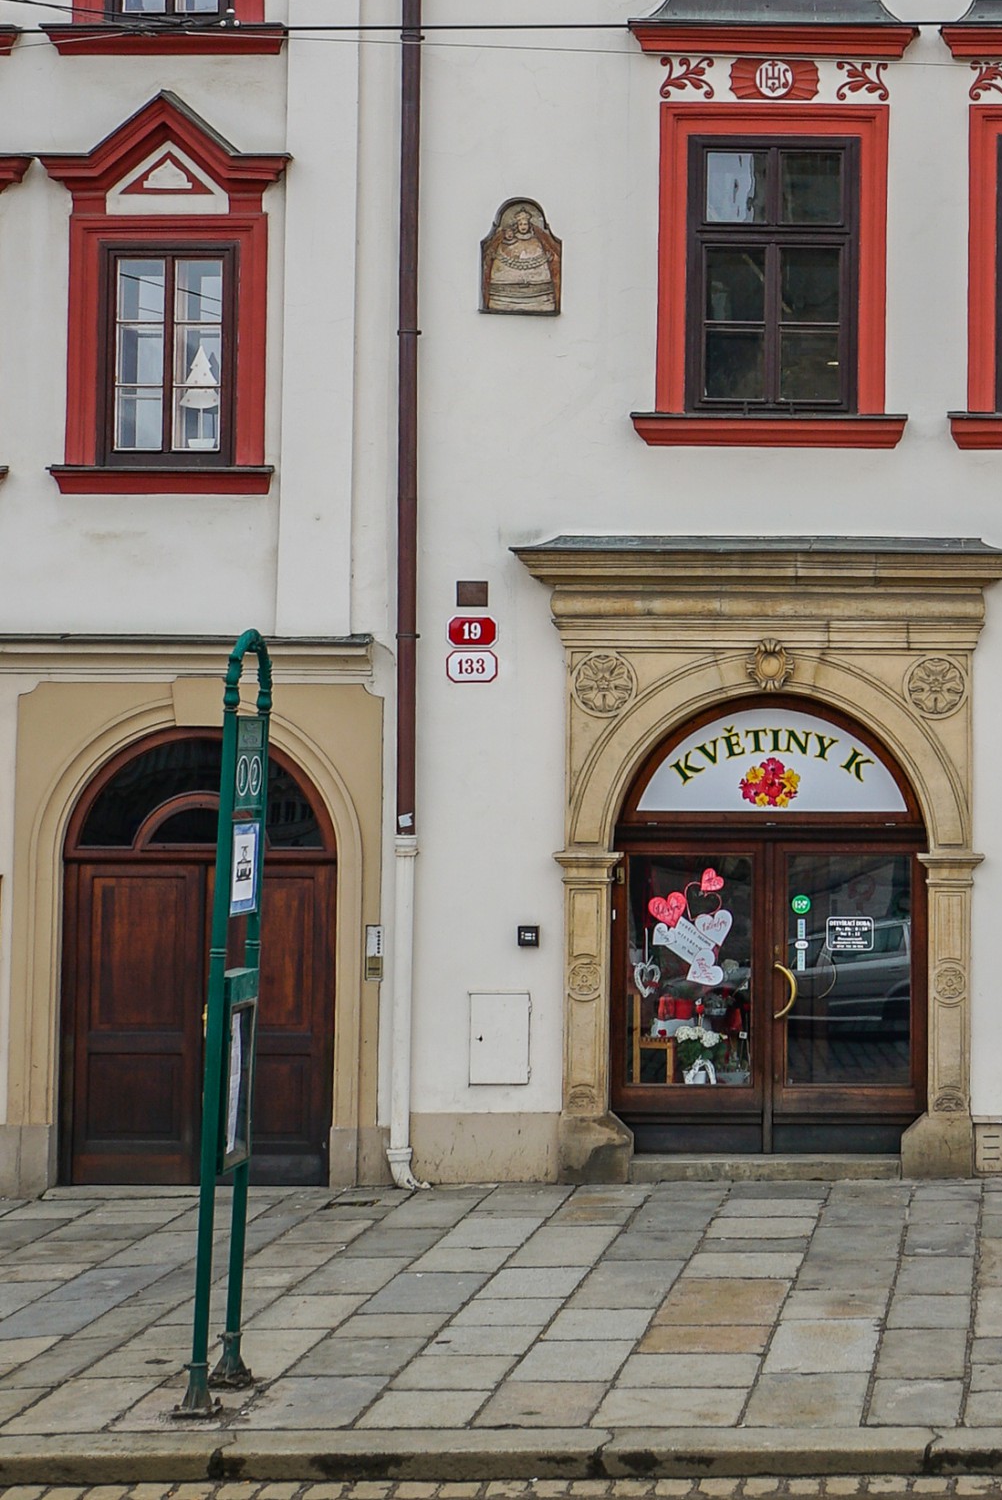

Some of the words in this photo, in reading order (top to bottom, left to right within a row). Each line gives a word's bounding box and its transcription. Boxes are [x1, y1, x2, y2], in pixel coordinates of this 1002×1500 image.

[463, 622, 482, 640] 19
[457, 658, 486, 675] 133
[669, 725, 839, 786] KVĚTINY
[840, 747, 875, 783] K
